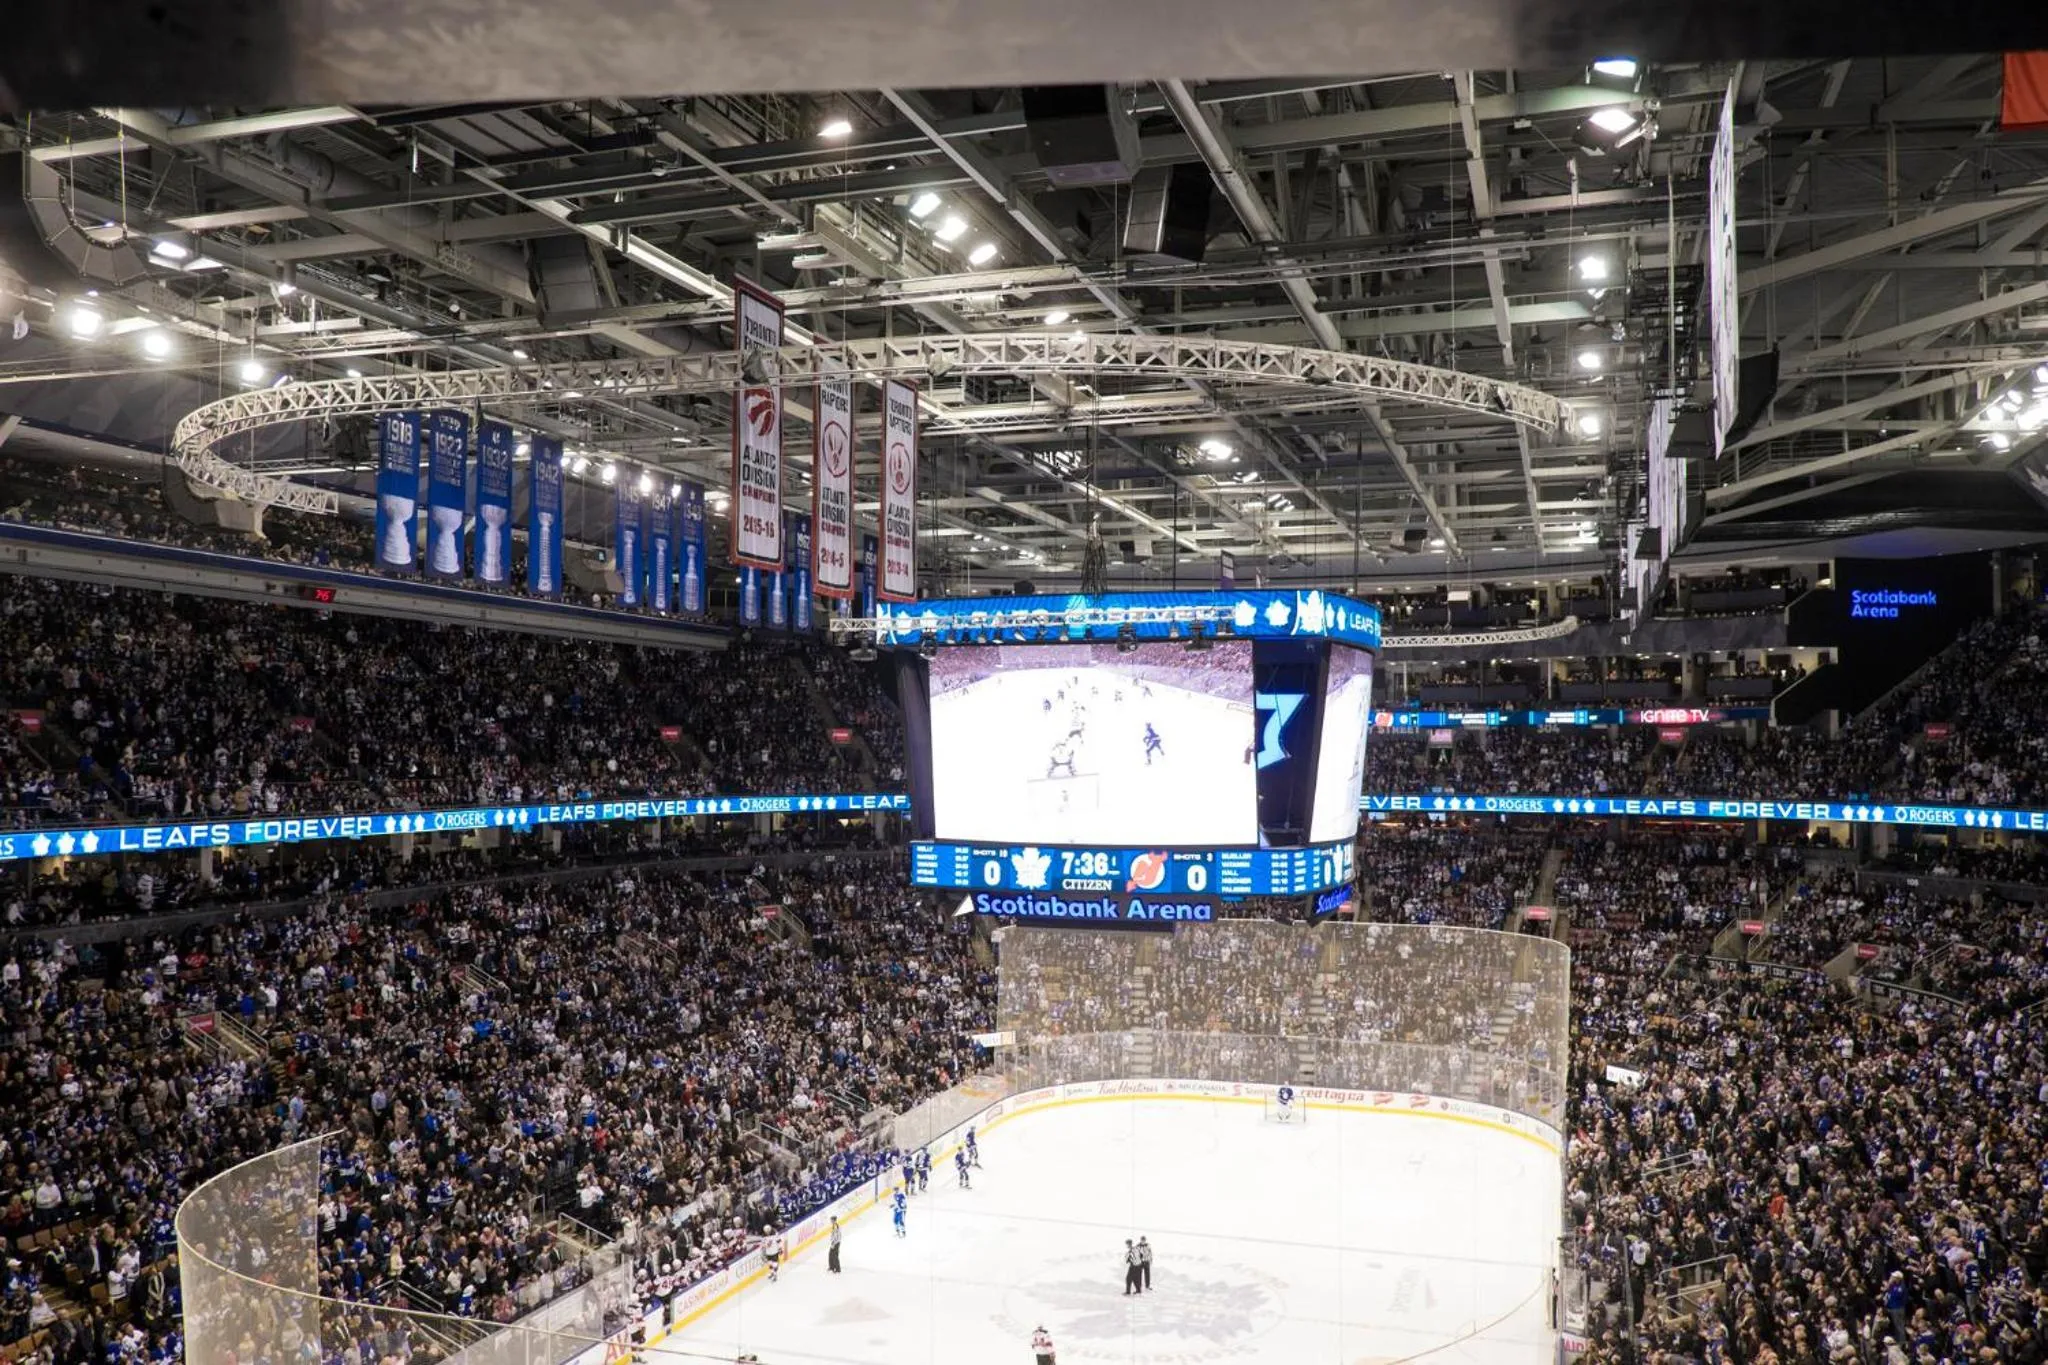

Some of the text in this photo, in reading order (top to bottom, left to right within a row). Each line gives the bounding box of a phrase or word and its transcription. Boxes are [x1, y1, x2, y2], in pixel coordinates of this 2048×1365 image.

[387, 417, 412, 444] 1918
[435, 432, 462, 458] 1922
[1852, 589, 1937, 604] Scotiabank
[1851, 604, 1898, 617] Arena
[120, 824, 230, 850] LEAFS
[245, 817, 372, 842] FOREVER
[447, 811, 487, 827] ROGERS
[538, 804, 597, 822] LEAFS
[603, 800, 687, 819] FOREVER
[752, 798, 790, 810] ROGERS
[1499, 800, 1543, 811] ROGERS
[1610, 801, 1696, 815] LEAFS
[1709, 802, 1831, 819] FOREVER
[1910, 809, 1956, 823] ROGERS
[984, 860, 1001, 886] 0
[1061, 851, 1108, 876] 7:36
[1062, 879, 1113, 891] CITIZEN
[1187, 865, 1207, 891] 0
[976, 893, 1211, 920] Scotiabank Arena
